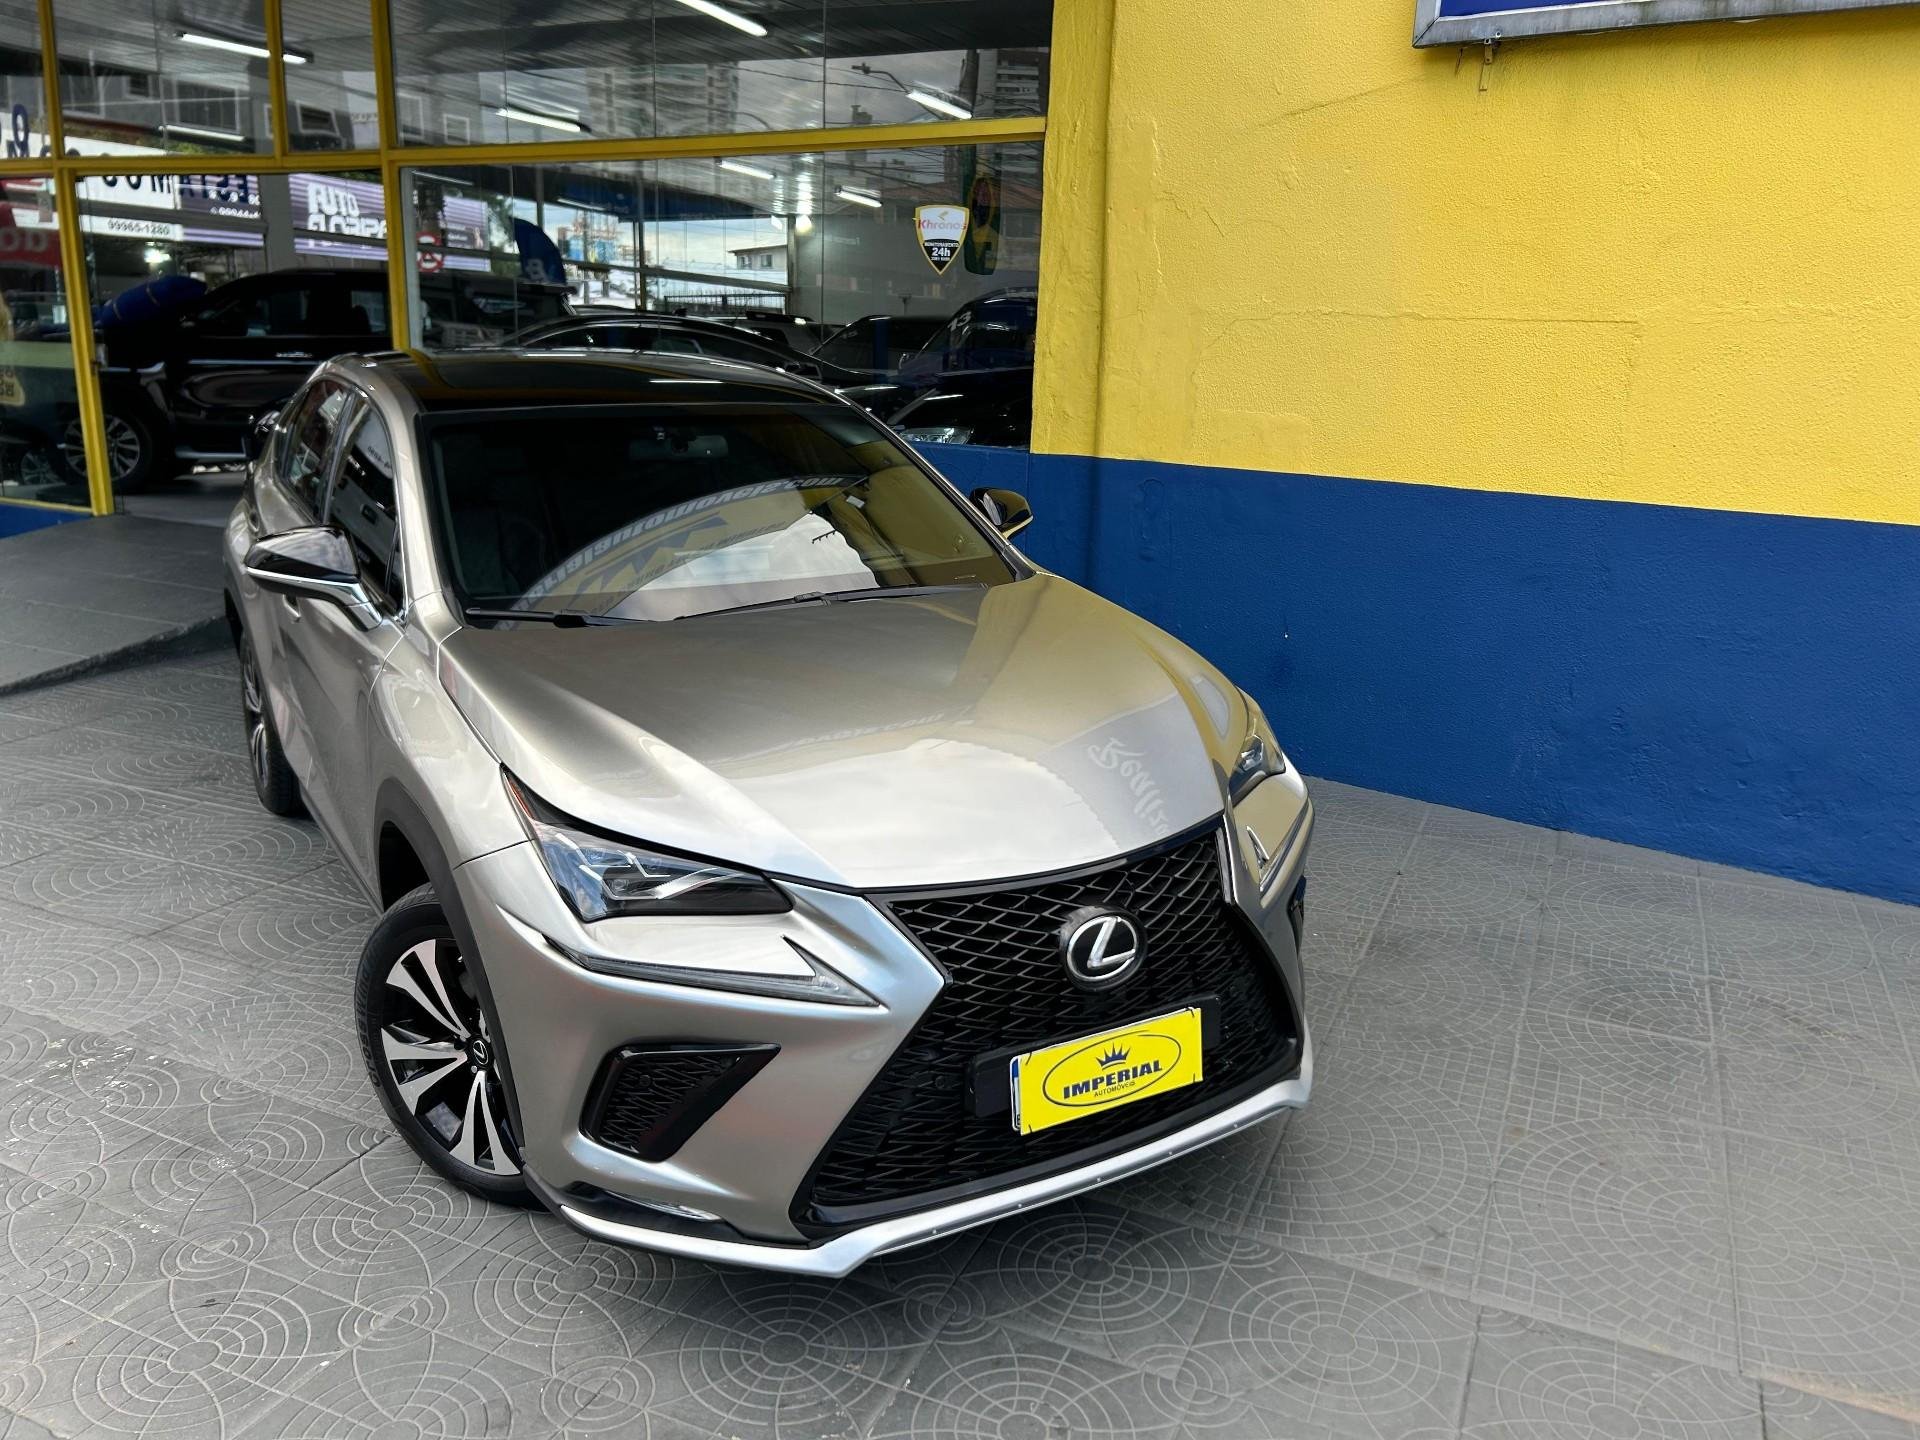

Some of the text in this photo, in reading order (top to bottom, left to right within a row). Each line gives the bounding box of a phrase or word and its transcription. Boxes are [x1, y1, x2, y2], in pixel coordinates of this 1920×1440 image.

[917, 218, 967, 231] Khronos
[931, 247, 951, 257] 24h
[1063, 1060, 1163, 1099] IMPERIAL
